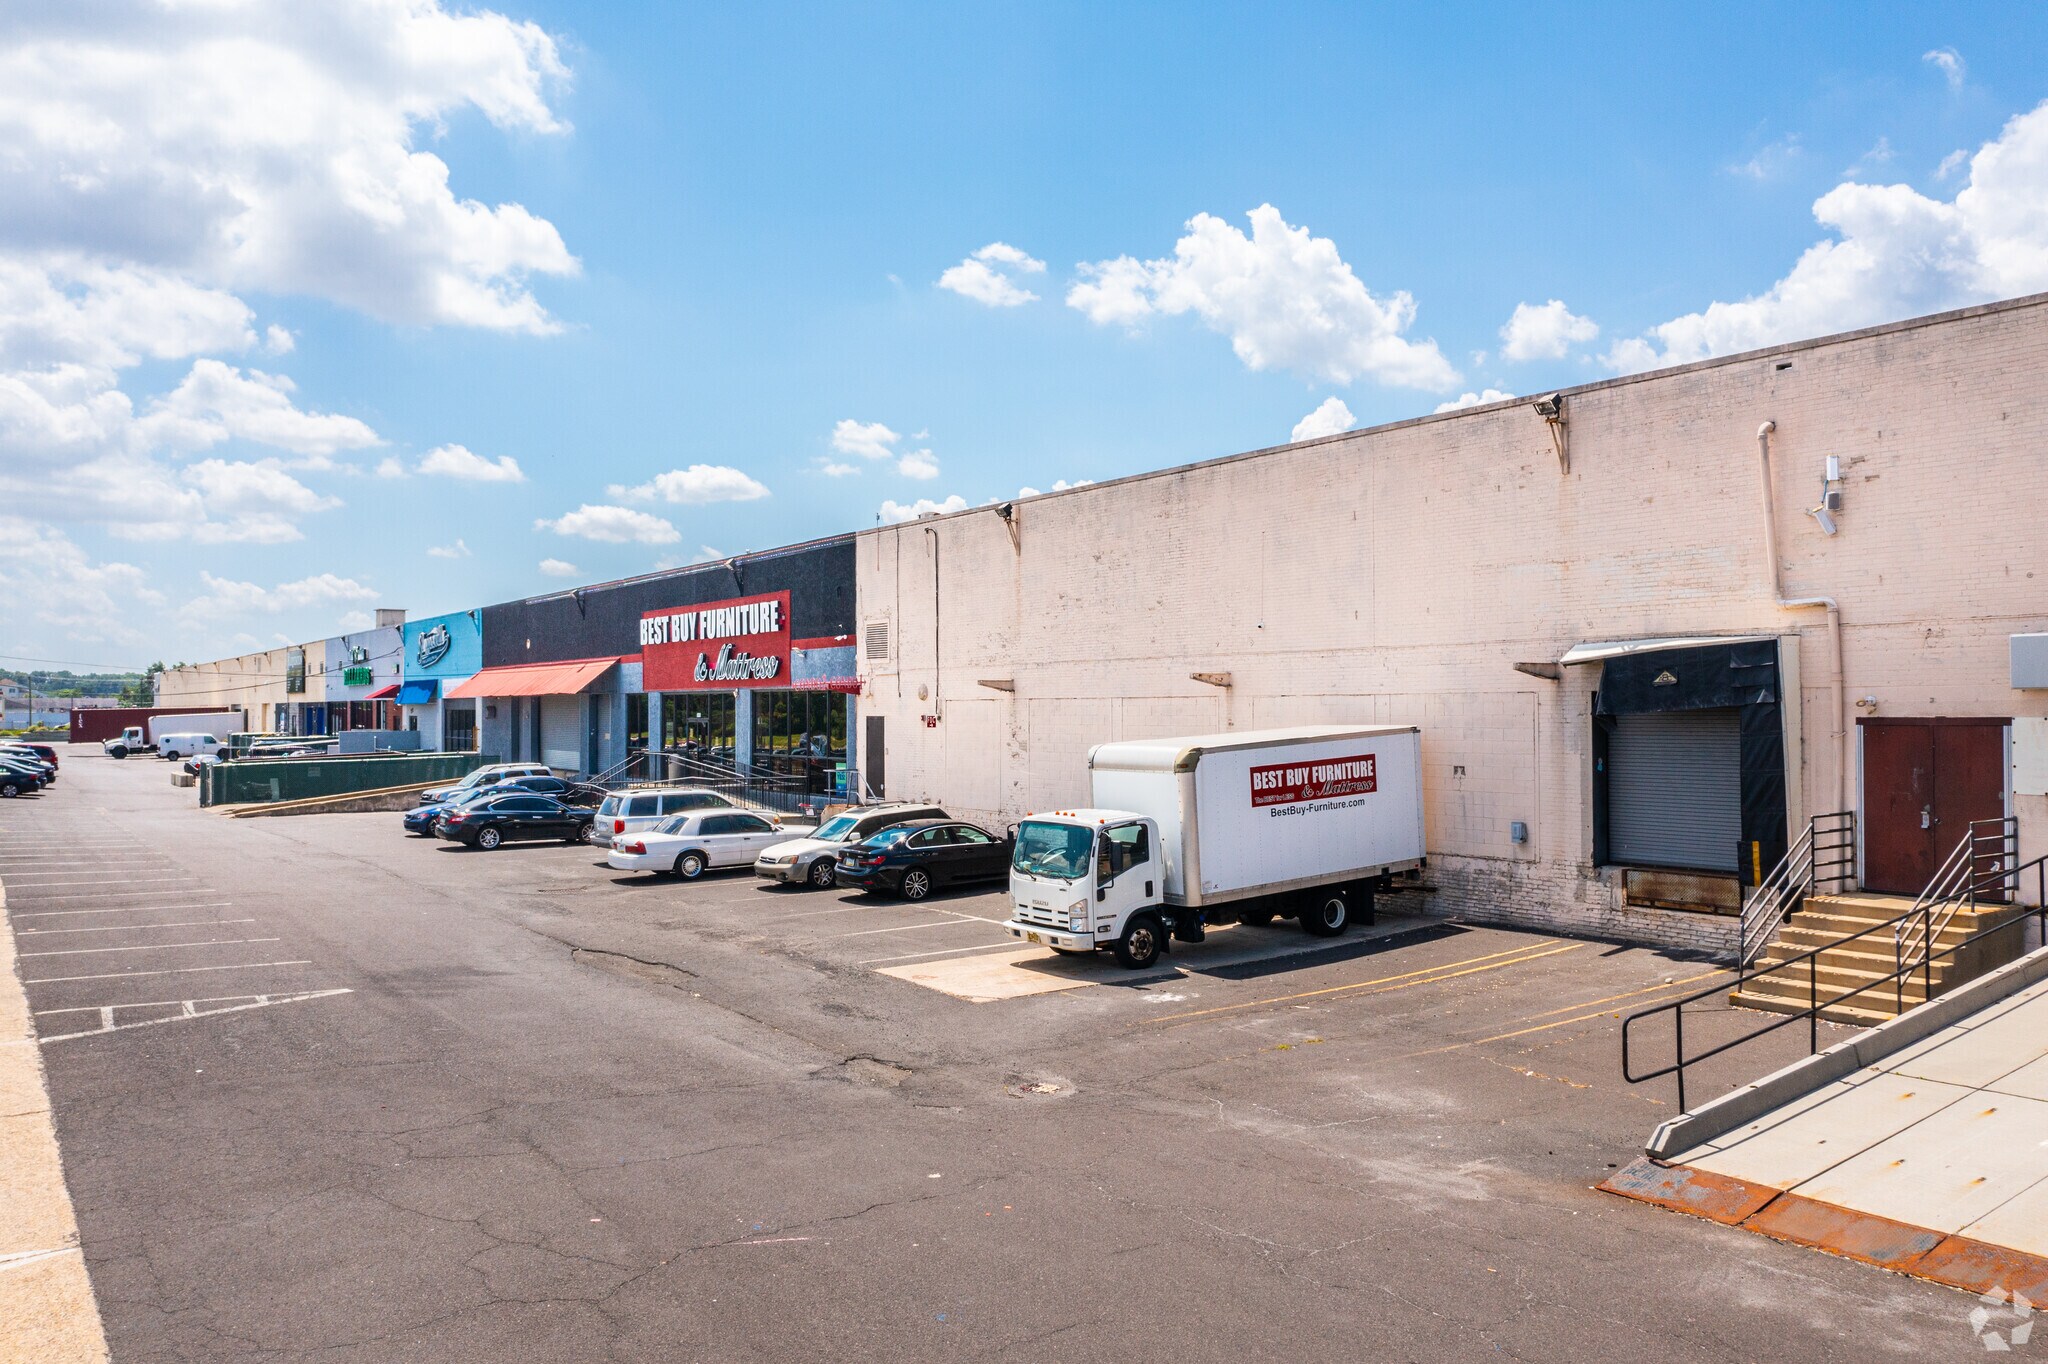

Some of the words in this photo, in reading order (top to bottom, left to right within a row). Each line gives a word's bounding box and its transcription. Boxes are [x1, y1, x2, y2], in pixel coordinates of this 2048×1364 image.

[640, 615, 669, 645] BEST
[671, 612, 697, 642] BUY
[700, 600, 778, 639] FURNITURE
[694, 653, 707, 681] &
[709, 643, 778, 680] Mattress
[1253, 770, 1283, 790] BEST
[1286, 767, 1309, 786] BUY
[1312, 760, 1373, 783] FURNITURE
[1301, 785, 1314, 798] &
[1316, 780, 1374, 796] Mattress
[1270, 798, 1365, 817] BestBuy-Furniture.com
